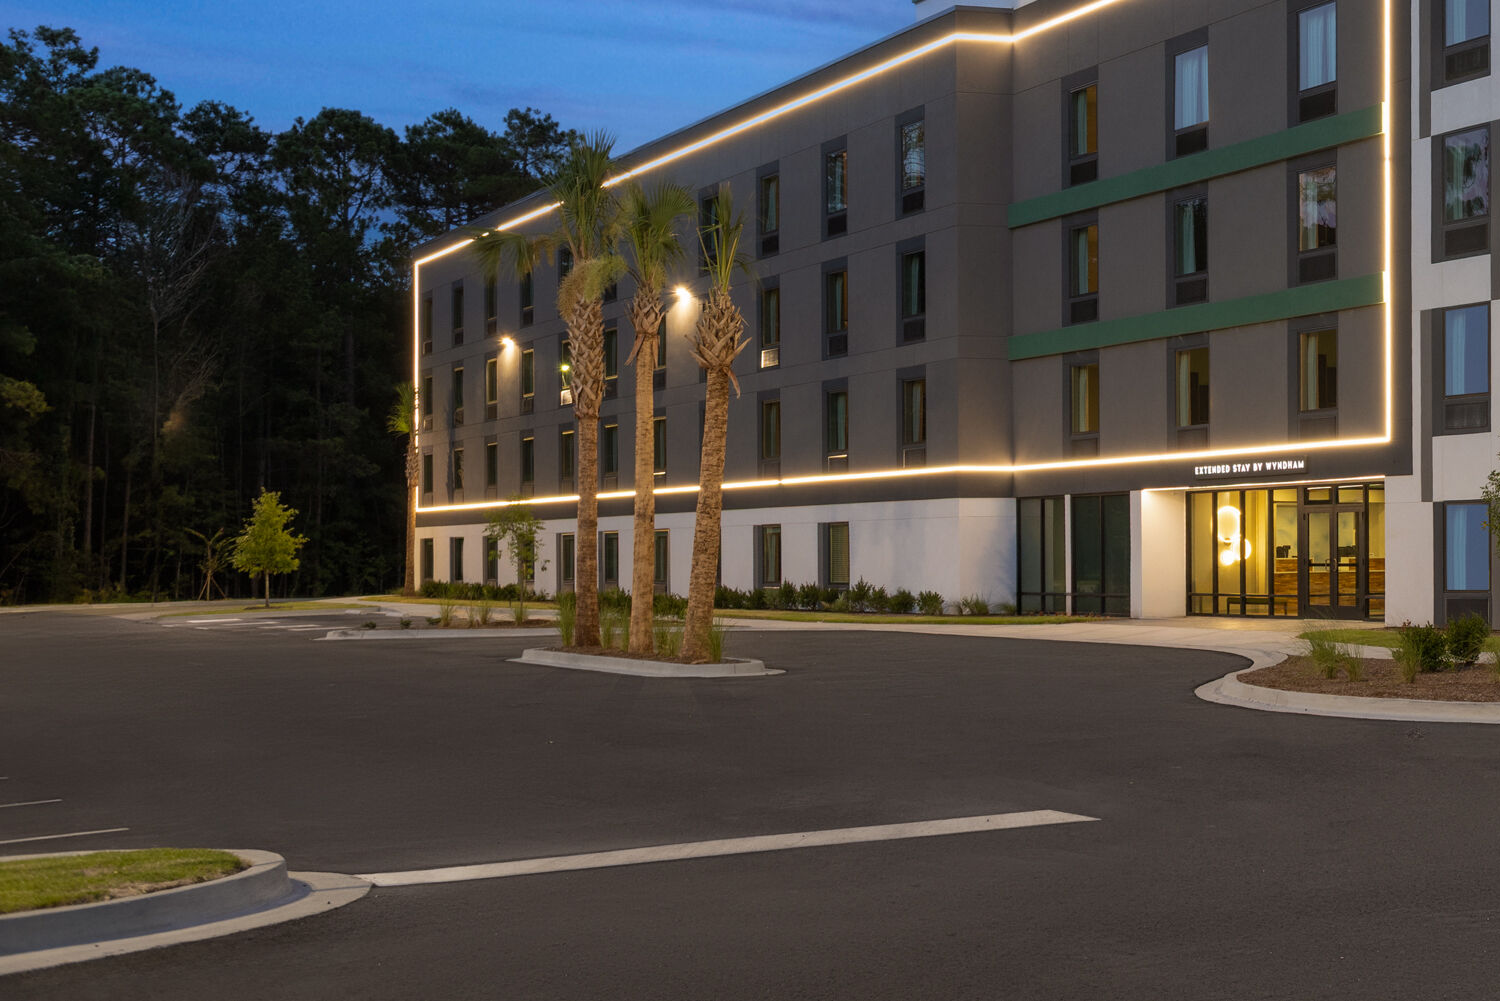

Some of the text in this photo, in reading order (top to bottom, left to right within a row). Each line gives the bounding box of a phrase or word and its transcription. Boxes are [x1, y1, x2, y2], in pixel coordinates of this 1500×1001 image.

[1194, 460, 1305, 475] EXTENDED STAY BY WYNDHAM
